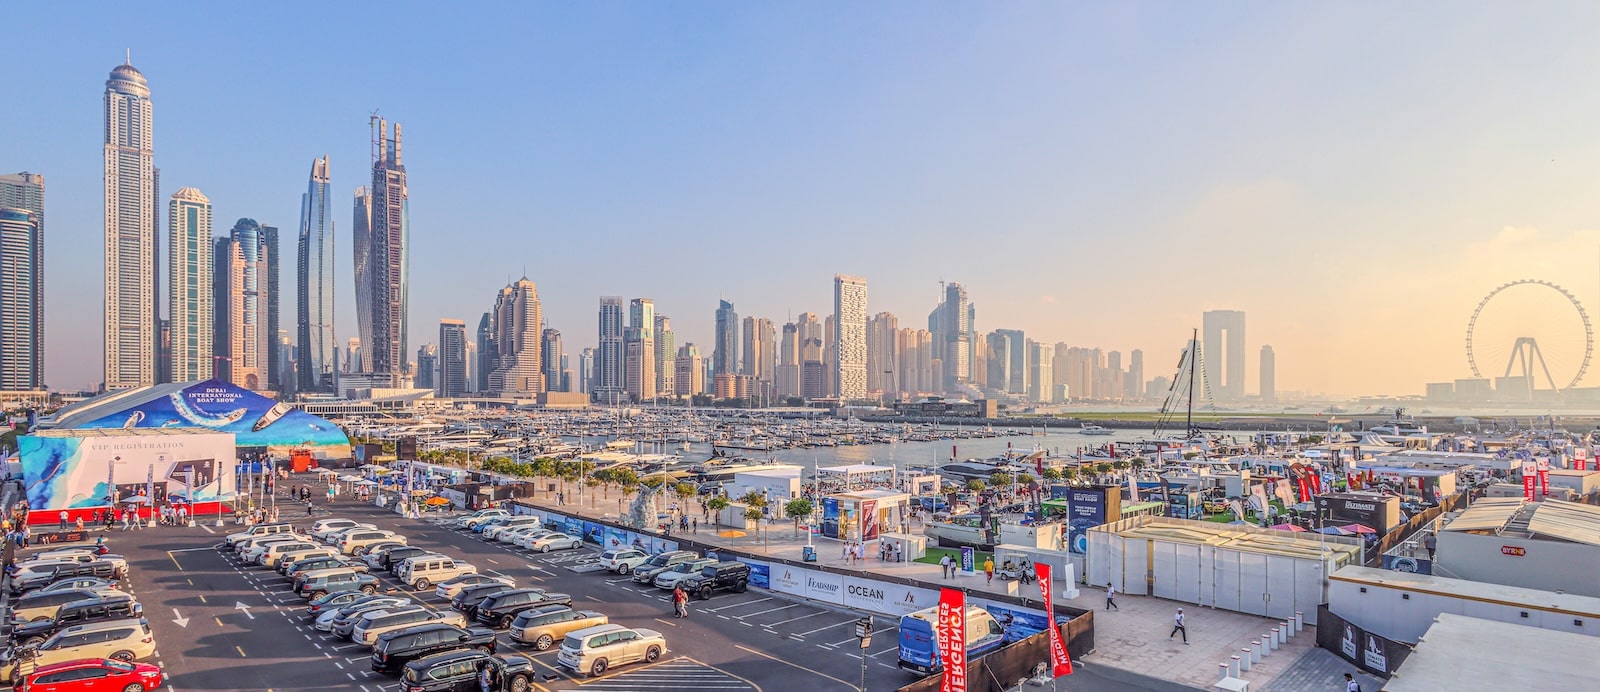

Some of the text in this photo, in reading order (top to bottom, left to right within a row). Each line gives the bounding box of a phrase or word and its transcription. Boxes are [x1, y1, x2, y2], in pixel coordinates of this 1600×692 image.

[113, 442, 184, 450] REGISTRATION
[1503, 547, 1524, 555] BYRNE
[848, 585, 884, 600] OCEAN
